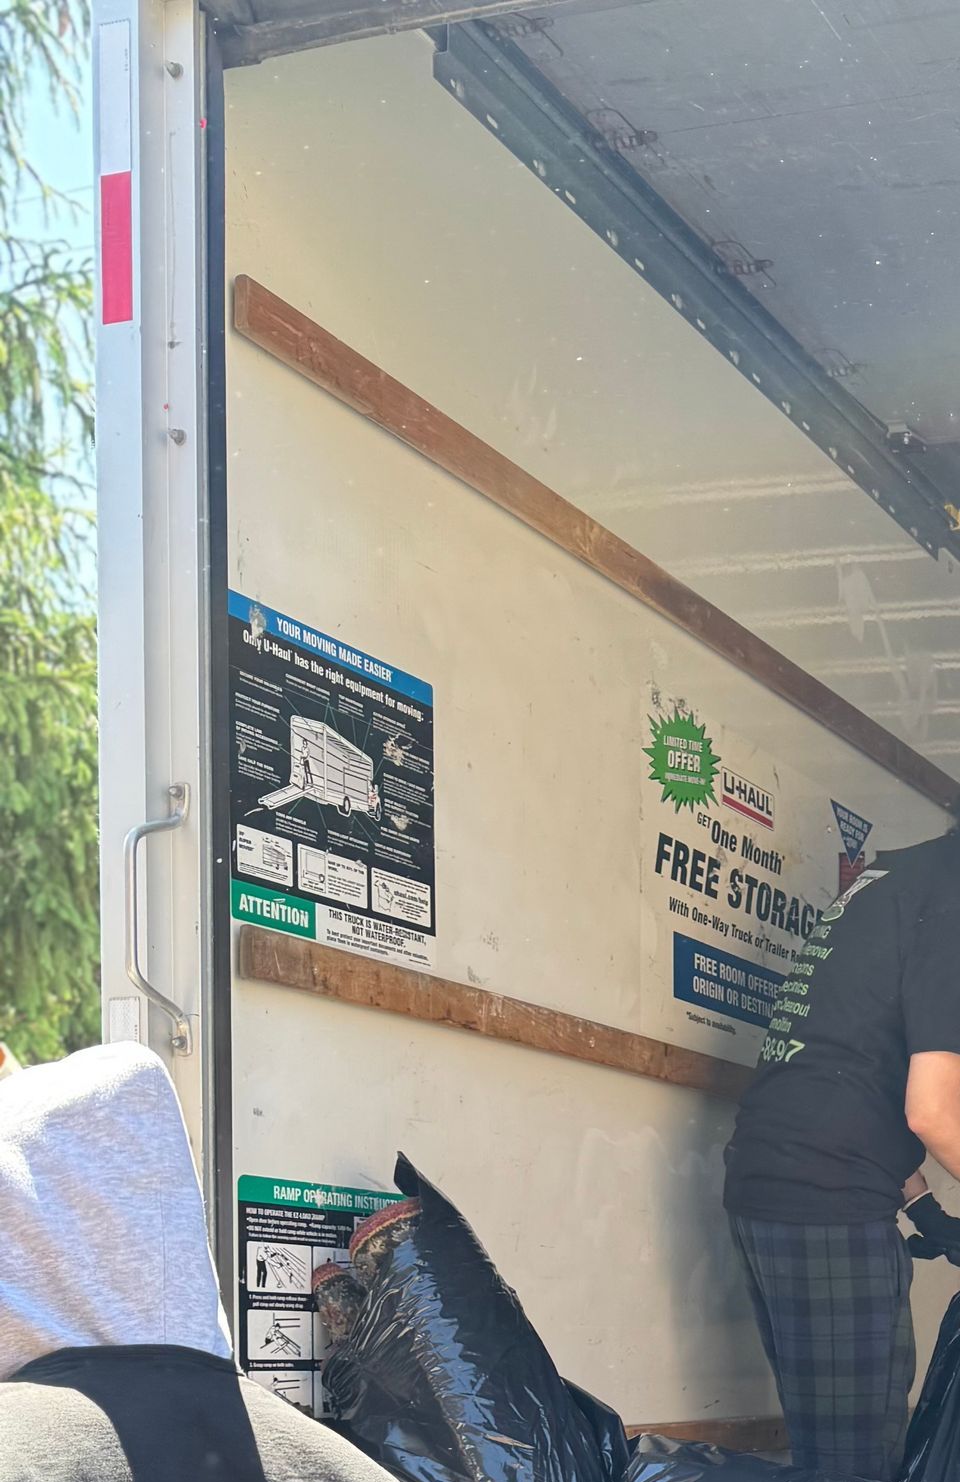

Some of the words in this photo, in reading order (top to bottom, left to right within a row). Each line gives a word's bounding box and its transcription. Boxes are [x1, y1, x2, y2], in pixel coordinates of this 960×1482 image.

[276, 617, 300, 640] YOUR
[302, 630, 336, 657] MOVING
[338, 646, 362, 668] MADE
[364, 658, 392, 682] EASIER
[294, 652, 309, 670] has
[310, 659, 324, 676] the
[325, 667, 344, 685] right
[345, 678, 384, 703] equipment
[384, 693, 396, 708] for
[396, 701, 424, 722] moving:
[663, 735, 687, 749] LIMITED
[688, 740, 703, 752] TIME
[667, 750, 701, 772] OFFER
[723, 772, 773, 816] U-HAUL
[697, 812, 711, 830] GET
[711, 820, 737, 852] One
[655, 832, 721, 899] FREE
[239, 893, 309, 928] ATTENTION
[328, 909, 342, 920] THIS
[344, 913, 364, 927] TRUCK
[365, 919, 372, 929] IS
[669, 896, 689, 918] With
[692, 904, 729, 937] One-Way
[732, 924, 753, 945] Truck
[755, 936, 763, 948] or
[765, 939, 790, 959] Trailer
[351, 925, 363, 936] NOT
[365, 929, 406, 948] WATERPROOF.
[693, 975, 724, 1002] ORIGIN
[726, 988, 739, 1007] OR
[694, 953, 717, 976] FREE
[719, 963, 746, 987] ROOM
[747, 974, 779, 999] OFFERE
[273, 1185, 301, 1201] RAMP
[303, 1189, 353, 1207] OPRATING
